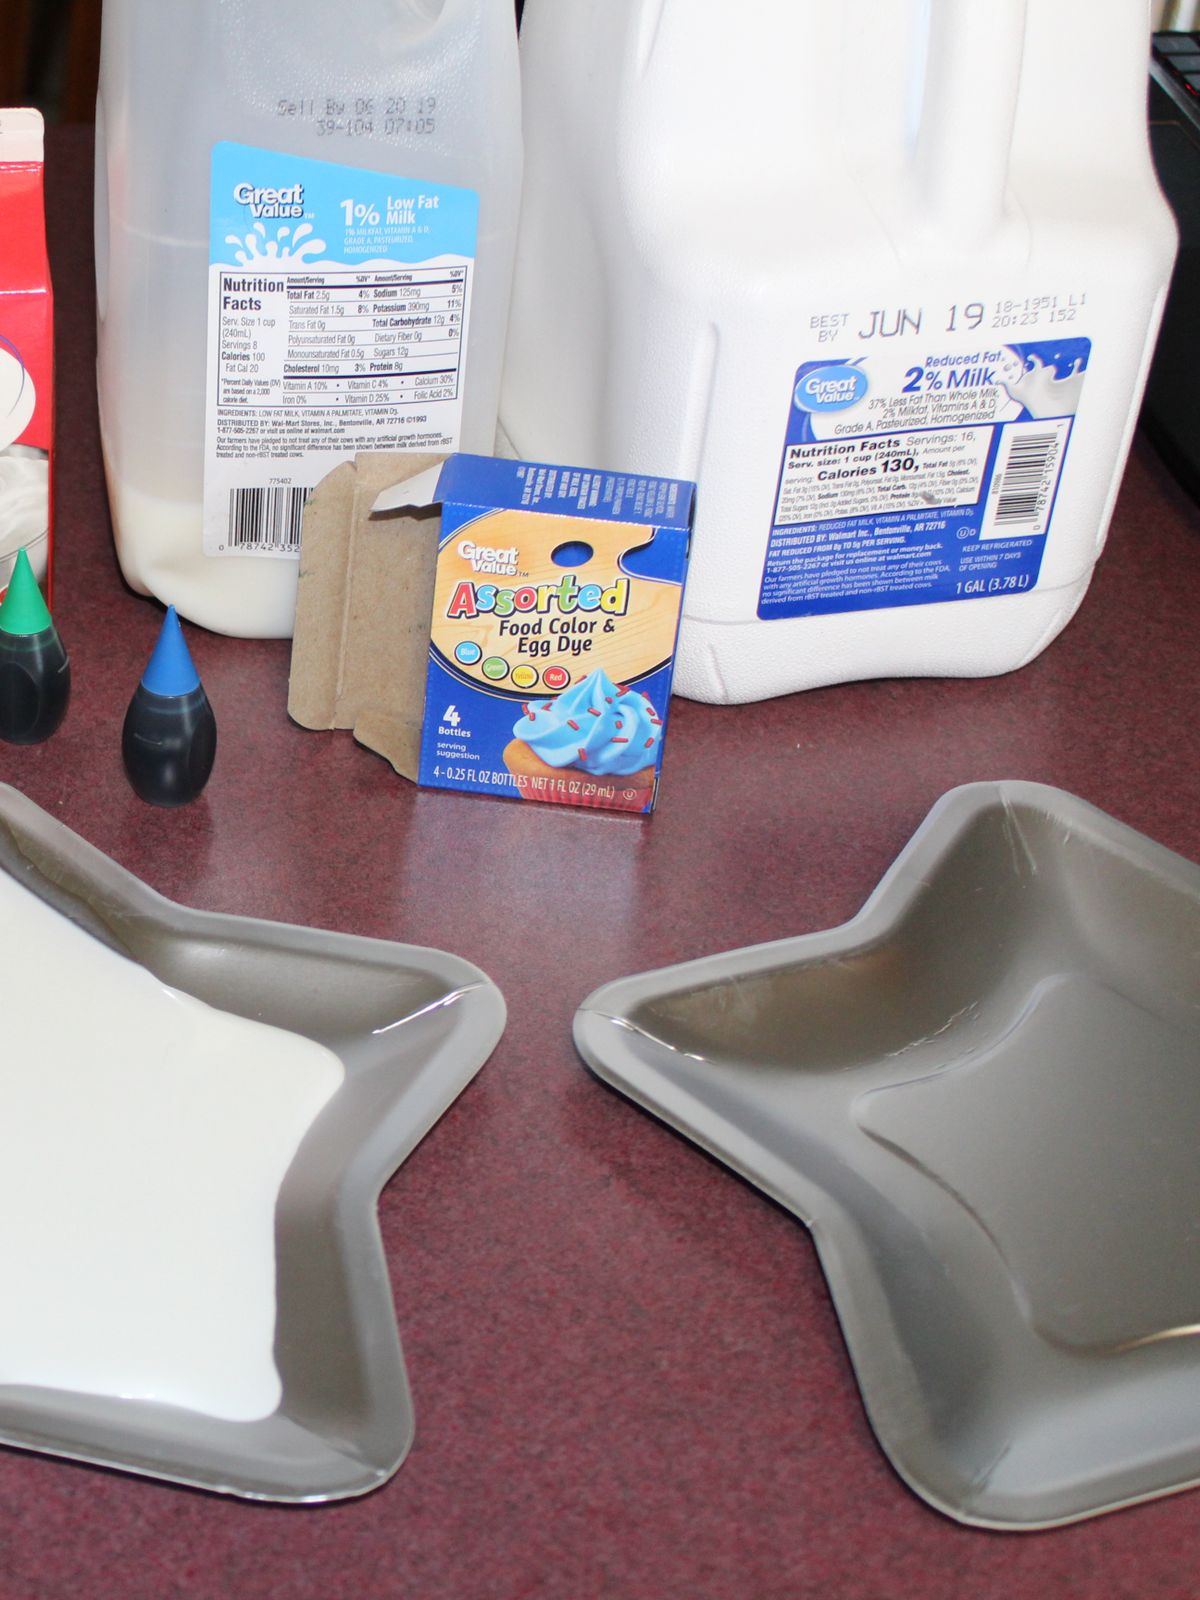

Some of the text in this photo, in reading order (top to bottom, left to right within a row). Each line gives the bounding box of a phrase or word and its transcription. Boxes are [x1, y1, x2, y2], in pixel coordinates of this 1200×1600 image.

[277, 99, 313, 116] Sell
[326, 99, 345, 116] By
[385, 98, 406, 114] 20
[417, 97, 436, 114] 19
[385, 118, 436, 135] 07:05
[233, 183, 304, 205] Great
[387, 194, 440, 210] Low Fat
[250, 202, 304, 218] Value
[340, 198, 380, 226] 1%
[386, 210, 416, 225] Milk
[223, 277, 284, 292] Nutrition
[287, 284, 463, 301] Total Fat 2.5g 4% Sodium 125mg 5%
[223, 296, 262, 311] Facts
[289, 299, 461, 316] Saturated Fat 1.5g 8% Potassium 390mg 11%
[222, 316, 239, 327] Serv.
[241, 316, 256, 327] Size
[263, 318, 276, 329] cup
[372, 313, 461, 328] Total Carbohydrate 12g 4%
[810, 312, 850, 330] BEST
[858, 307, 923, 339] JUN
[945, 302, 986, 332] 19
[994, 296, 1058, 314] 18-1951
[818, 308, 1077, 343] BY 20:23 152
[222, 328, 252, 339] (240mL)
[222, 340, 251, 351] Servings
[221, 351, 266, 361] Calories 100
[925, 352, 980, 368] Reduced
[283, 361, 403, 374] Cholesterol 10mg 3% Protein 8g
[805, 375, 858, 395] Great
[901, 366, 996, 394] 2% Milk
[815, 389, 855, 404] Value
[834, 423, 864, 436] Grade
[930, 410, 995, 425] Homogenized
[790, 444, 856, 459] Nutrition
[860, 438, 900, 451] Facts
[906, 433, 957, 446] Servings:
[787, 460, 814, 469] Serv.
[817, 457, 842, 467] size:
[853, 455, 872, 464] cup
[817, 457, 920, 482] Calories 130,
[1035, 479, 1052, 512] 78742
[240, 543, 274, 551] 78742
[457, 540, 519, 563] Great
[962, 539, 1033, 553] KEEP REFRIGERATED
[471, 559, 518, 577] Value
[956, 573, 1031, 594] 1 GAL (3.78 L)
[448, 576, 629, 617] Assorted
[499, 617, 615, 636] Food Color &
[518, 636, 593, 657] Egg Dye
[549, 673, 563, 682] Red
[443, 705, 461, 727] 4
[438, 727, 472, 738] Bottles
[436, 742, 466, 752] serving
[436, 750, 480, 761] suggestion
[433, 765, 615, 799] 4 0.25 FL OZ BOTTLES NET 1 FL OZ (29 mL)
